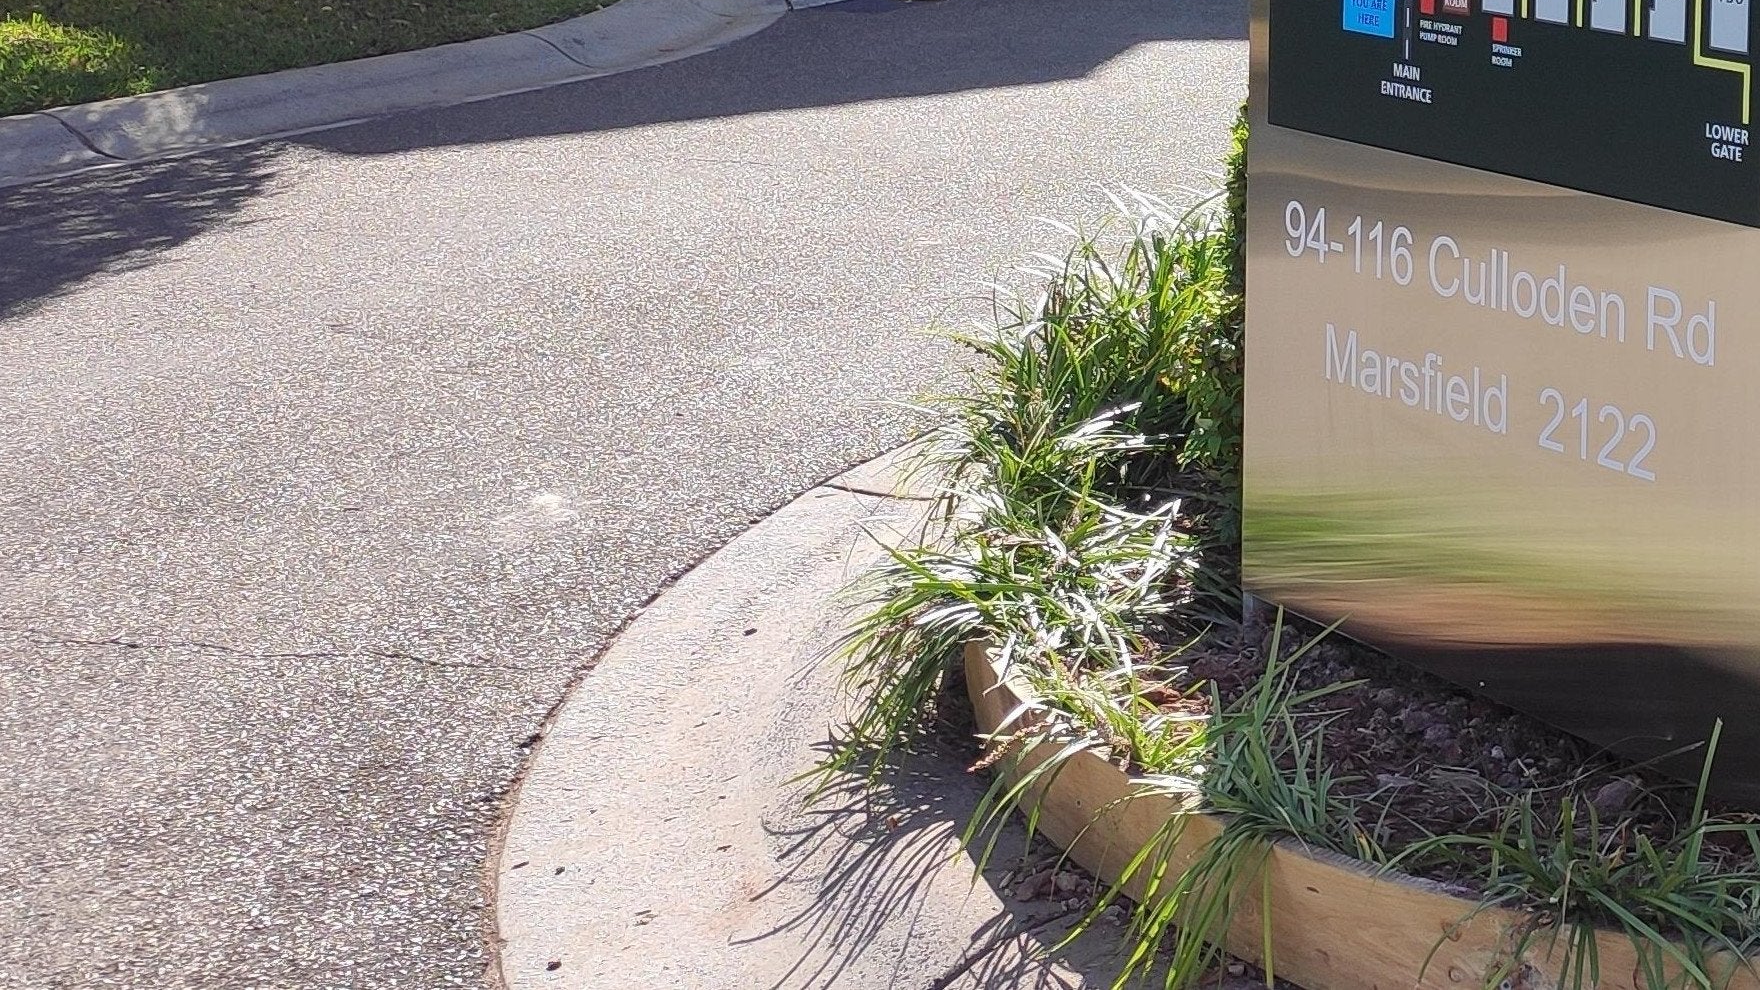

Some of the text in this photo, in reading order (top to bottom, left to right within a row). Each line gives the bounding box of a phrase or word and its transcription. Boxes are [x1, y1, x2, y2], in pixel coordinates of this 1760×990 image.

[1371, 0, 1387, 11] ARE
[1358, 13, 1380, 27] HERE
[1420, 19, 1462, 35] FIRE HYDRANT
[1419, 31, 1458, 46] PUMP ROOM
[1491, 55, 1513, 67] ROOM
[1393, 63, 1421, 82] MAIN
[1381, 81, 1432, 104] ENTRANCE
[1706, 122, 1749, 146] LOWER
[1711, 142, 1743, 162] GATE
[1284, 200, 1716, 367] 94-116 Culloden Rd
[1325, 322, 1657, 483] Marsfield 2122
